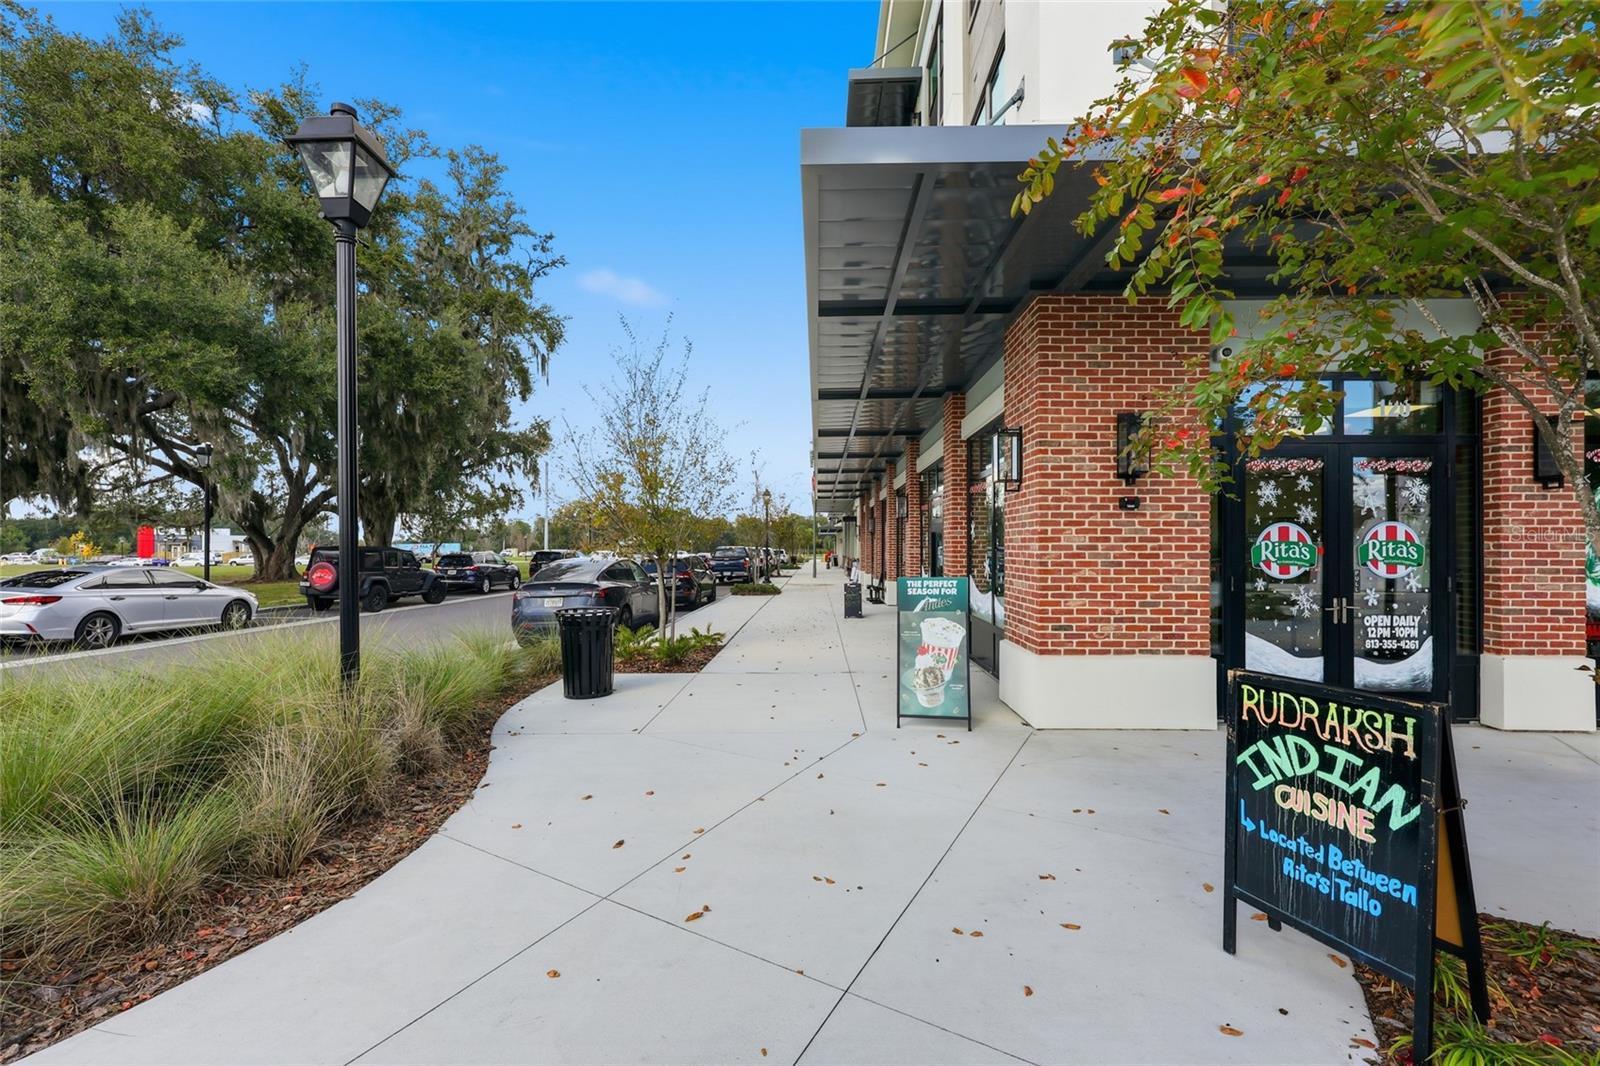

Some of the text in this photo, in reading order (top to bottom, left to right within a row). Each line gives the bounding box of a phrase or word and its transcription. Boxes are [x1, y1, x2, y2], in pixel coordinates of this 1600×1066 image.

[1261, 541, 1310, 561] Rita's
[1368, 540, 1417, 561] Rita's
[1364, 615, 1421, 628] OPEN DAILY
[1365, 639, 1419, 649] 813-355-4261
[1241, 684, 1417, 761] RUDRAKSH
[1236, 734, 1421, 832] INDIAN
[1275, 784, 1377, 844] CUISINE
[1260, 820, 1417, 907] Located Between
